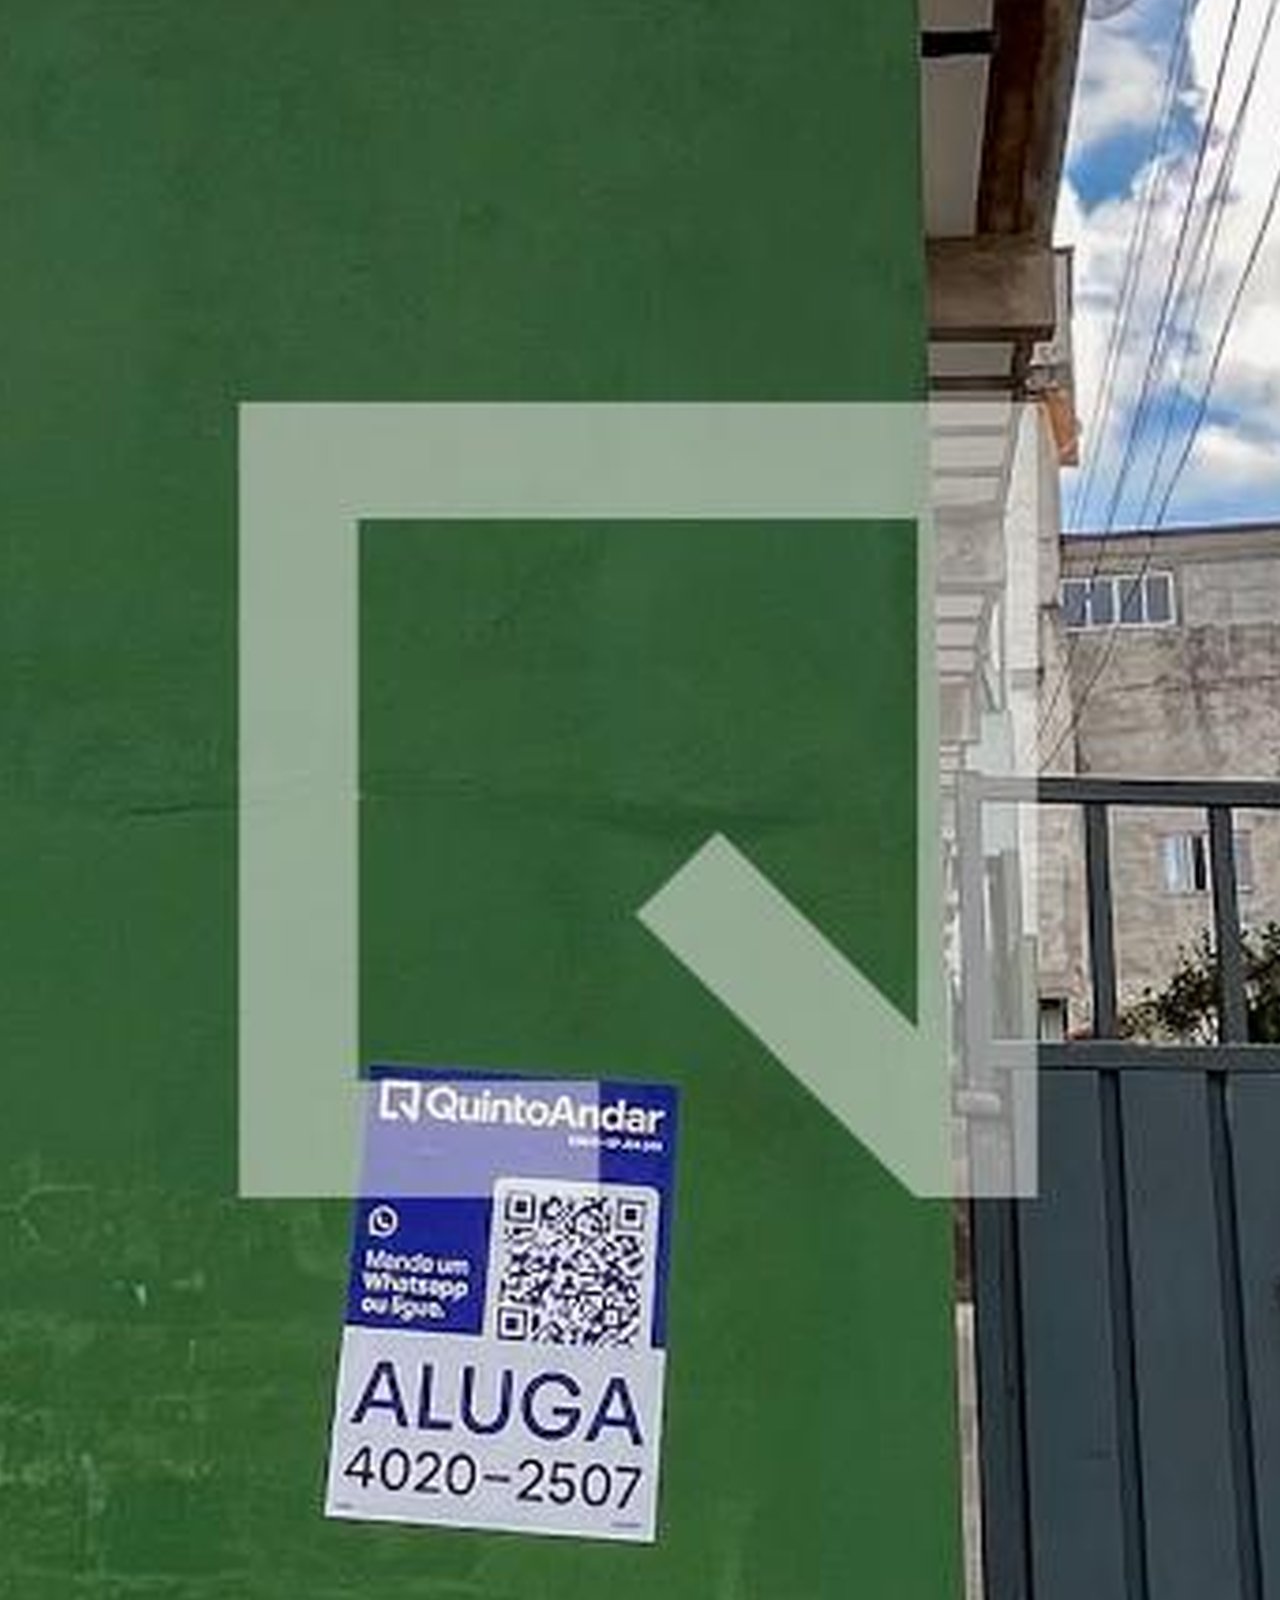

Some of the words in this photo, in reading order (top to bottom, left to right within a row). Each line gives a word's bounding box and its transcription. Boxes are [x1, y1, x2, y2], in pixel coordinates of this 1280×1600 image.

[425, 1084, 667, 1135] QuintoAndar
[437, 1258, 470, 1276] um
[361, 1296, 389, 1314] ou
[349, 1360, 645, 1446] ALUGA
[343, 1444, 643, 1511] 4020-2507
